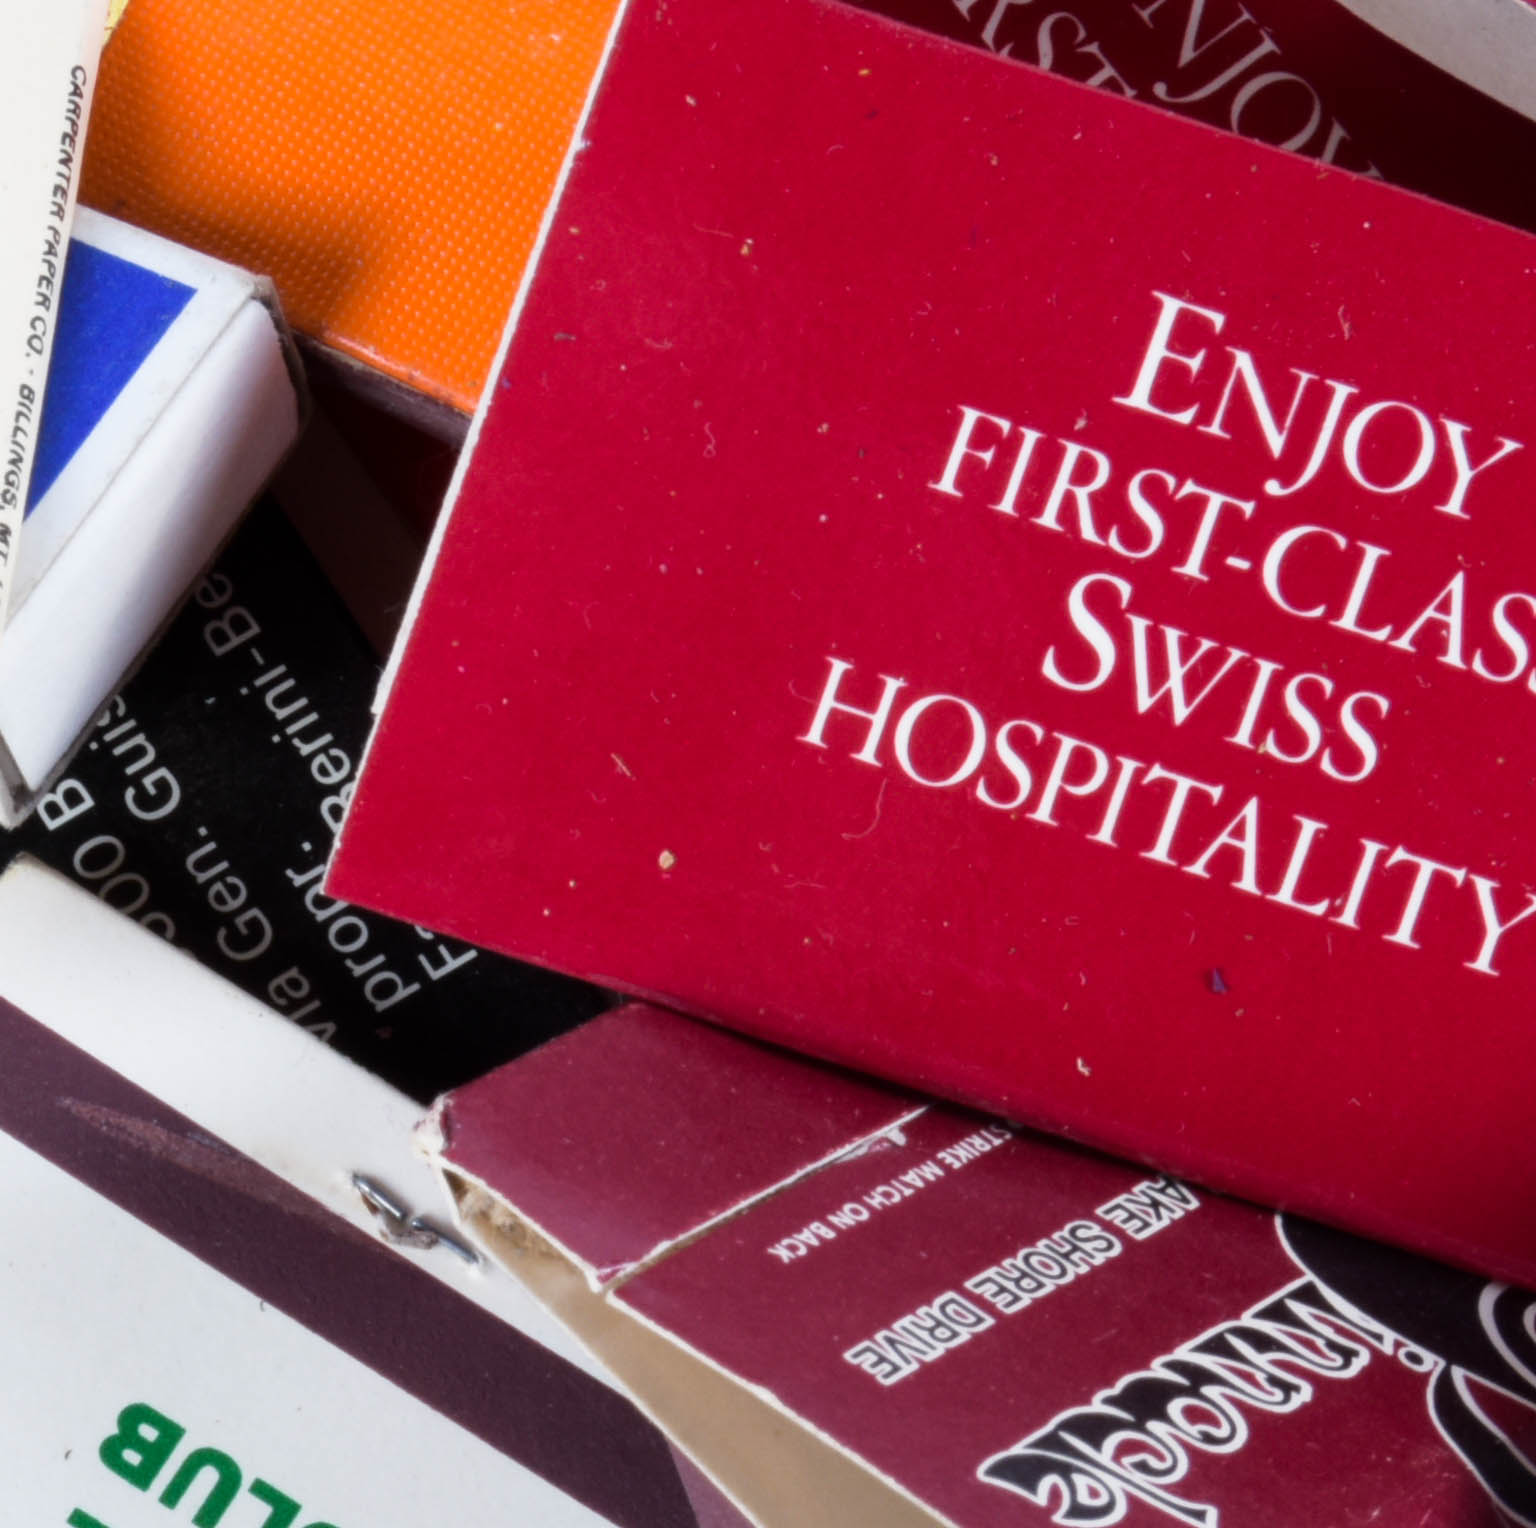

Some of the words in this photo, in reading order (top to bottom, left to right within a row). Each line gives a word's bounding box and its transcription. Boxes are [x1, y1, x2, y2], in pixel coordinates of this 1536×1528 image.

[48, 64, 87, 222] CARPENTER
[34, 226, 66, 312] PAPER
[24, 315, 50, 360] CO.
[1111, 289, 1525, 522] ENJOY
[927, 403, 1536, 692] FIRST-CLAS
[1041, 571, 1391, 783] SWISS
[795, 655, 1536, 977] HOSPITALITY
[183, 823, 273, 964] Gen.
[284, 840, 420, 1014] propr.
[876, 1152, 955, 1211] MATCH
[937, 1118, 1025, 1168] STRIKE
[766, 1210, 840, 1264] BACK
[837, 1191, 886, 1226] ON
[964, 1209, 1126, 1315] SHORE
[841, 1286, 996, 1386] DRIVE
